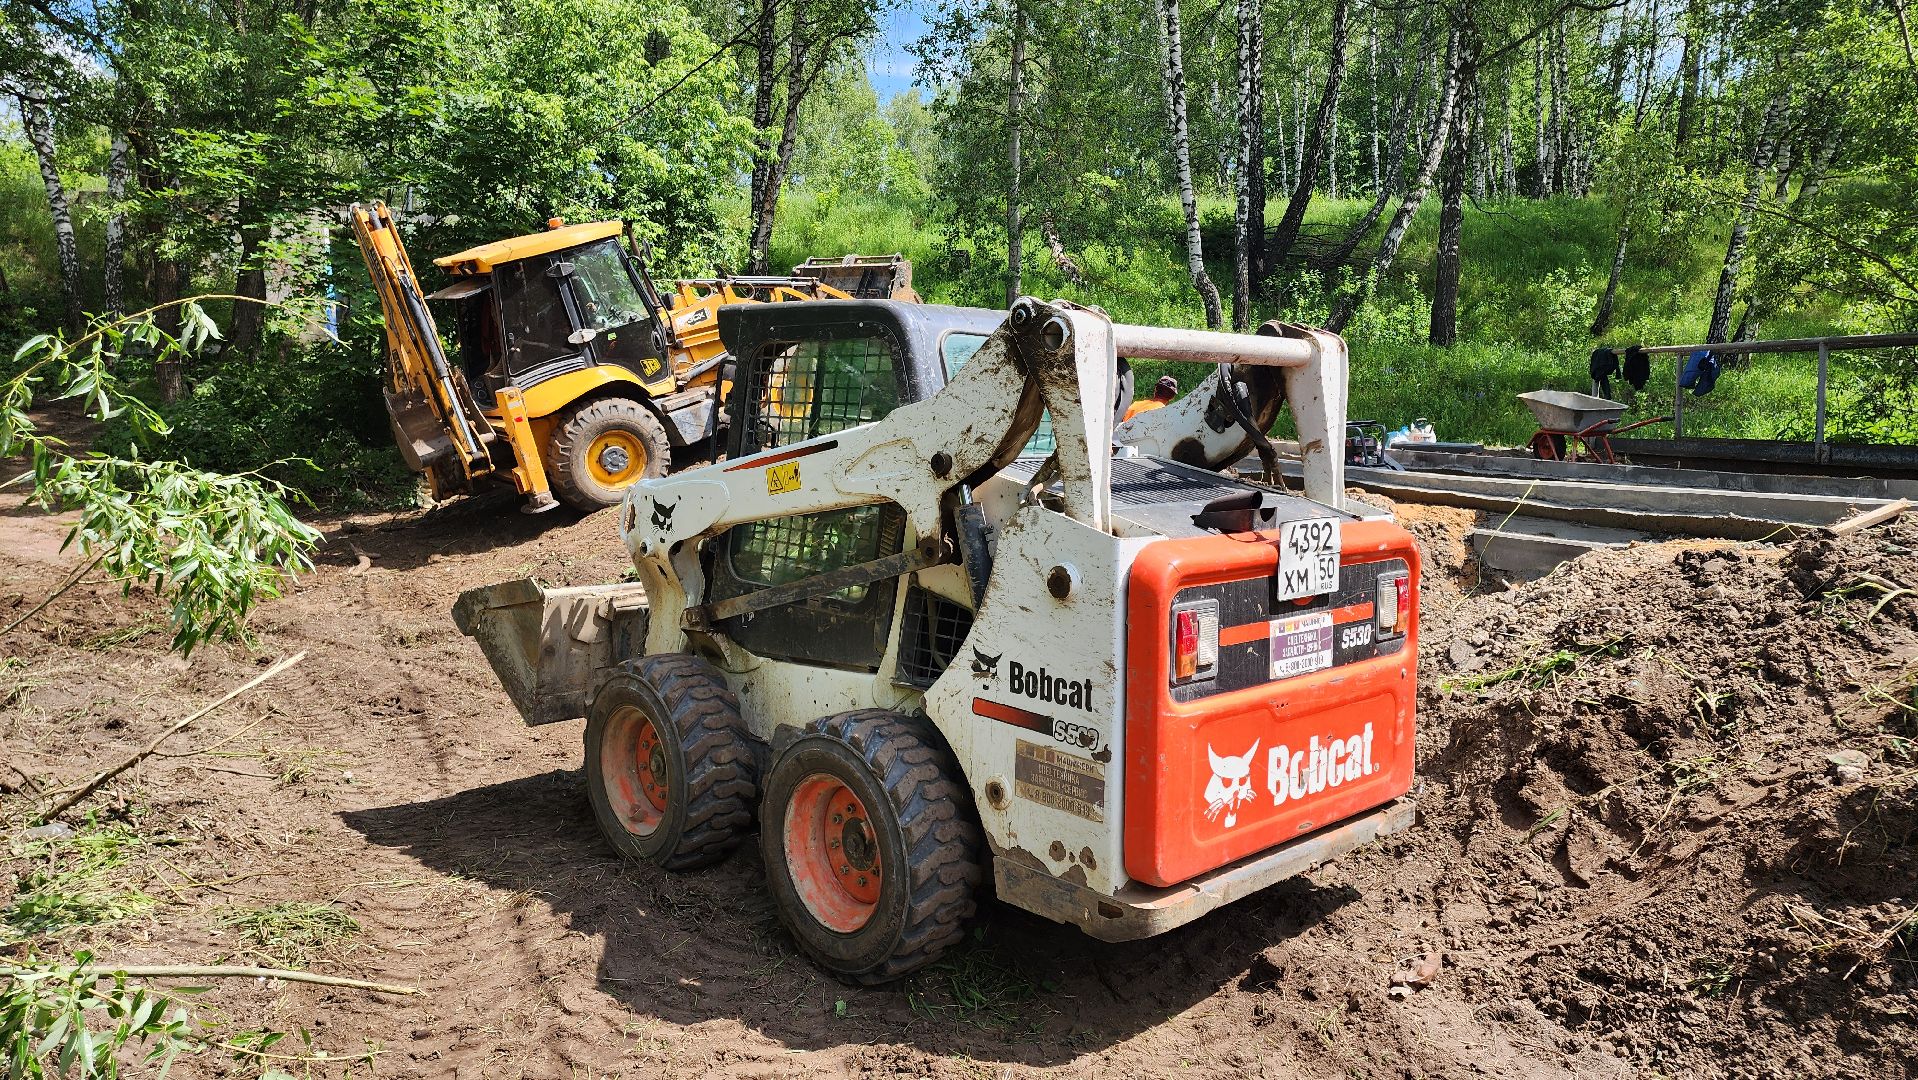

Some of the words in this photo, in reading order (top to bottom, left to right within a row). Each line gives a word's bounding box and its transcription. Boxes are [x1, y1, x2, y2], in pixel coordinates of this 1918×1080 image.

[1289, 522, 1333, 555] 4392
[1319, 557, 1334, 580] 50
[1321, 581, 1333, 590] RUS
[1341, 623, 1372, 650] S530
[1009, 660, 1093, 713] Bobcat
[1267, 721, 1374, 807] Bobcat
